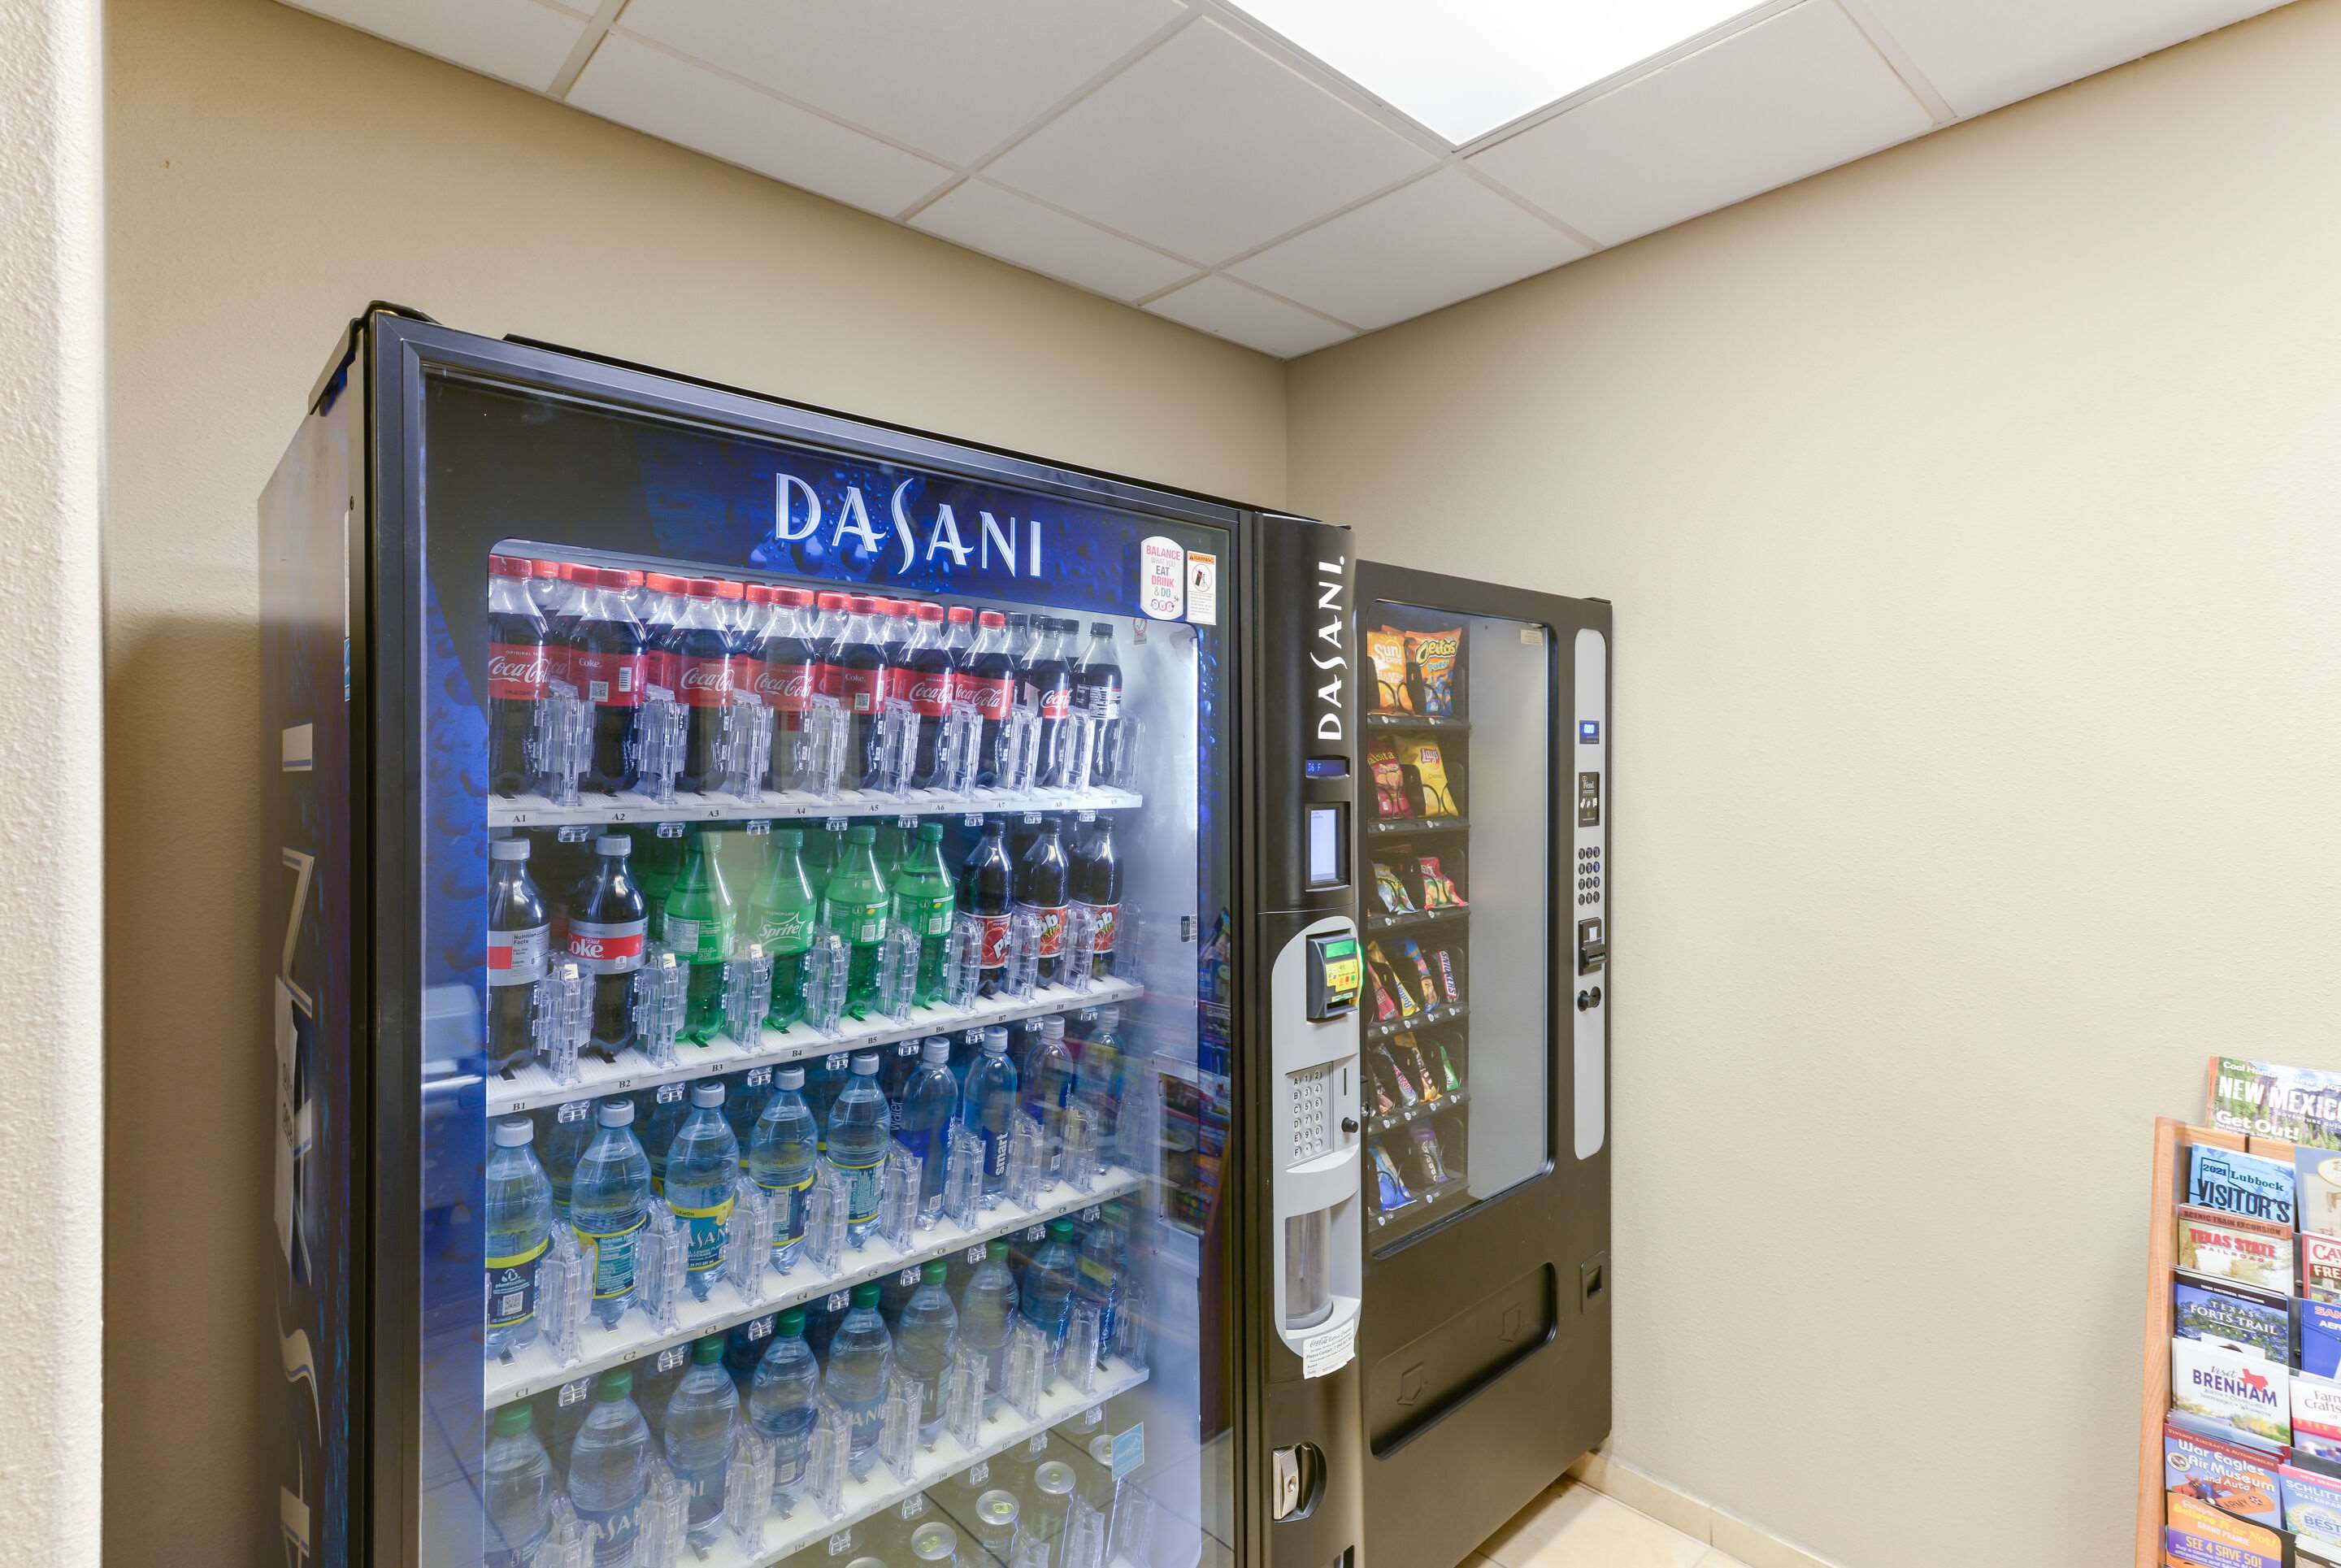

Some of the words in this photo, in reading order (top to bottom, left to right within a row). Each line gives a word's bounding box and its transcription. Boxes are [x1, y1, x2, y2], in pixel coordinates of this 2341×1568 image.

[775, 471, 1042, 577] DASANI
[1146, 545, 1181, 561] BALANCE
[1151, 575, 1175, 588] DRINK
[1156, 565, 1170, 576] EAT
[1153, 586, 1159, 596] &
[1161, 588, 1171, 597] DO
[579, 657, 600, 668] Coke
[845, 672, 866, 683] Coke
[513, 814, 526, 823] A1
[612, 813, 625, 821] A2
[708, 810, 719, 818] A3
[870, 804, 879, 812] A5
[759, 923, 800, 937] Sprite
[568, 937, 605, 958] oke
[513, 1102, 525, 1110] B1
[619, 1079, 631, 1088] B2
[712, 1063, 723, 1072] B3
[792, 1049, 802, 1058] B4
[867, 1036, 878, 1045] B5
[2222, 1061, 2246, 1071] Cool
[2218, 1075, 2265, 1105] NEW
[2216, 1110, 2252, 1130] Get
[2255, 1118, 2300, 1141] Out!
[995, 1131, 1009, 1176] smart
[2203, 1164, 2227, 1177] 2021
[2230, 1171, 2285, 1192] Lubbock
[2197, 1178, 2291, 1224] VISITOR'S
[2183, 1210, 2212, 1221] SCENIC
[2213, 1216, 2235, 1227] TRAIN
[2236, 1221, 2282, 1236] EXCURSION
[2189, 1227, 2232, 1249] TEXAS
[2234, 1237, 2276, 1258] STATE
[2200, 1244, 2265, 1263] RAILROAD
[2191, 1304, 2234, 1323] FORTS
[2236, 1316, 2278, 1336] TRAIL
[2210, 1301, 2254, 1318] TEXAS
[515, 1387, 528, 1398] C1
[623, 1350, 636, 1361] C2
[705, 1325, 716, 1334] C3
[797, 1292, 807, 1301] C4
[868, 1268, 878, 1277] C5
[2211, 1366, 2237, 1379] Visit
[2192, 1369, 2278, 1408] BRENHAM
[2178, 1439, 2210, 1457] War
[2213, 1451, 2265, 1476] Eagles
[2188, 1455, 2209, 1469] Air
[2210, 1462, 2275, 1492] Museum
[2203, 1475, 2222, 1484] and
[2223, 1479, 2250, 1492] Auto
[2185, 1535, 2204, 1551] SEE
[2206, 1542, 2213, 1553] 4
[2215, 1544, 2242, 1562] SAVE
